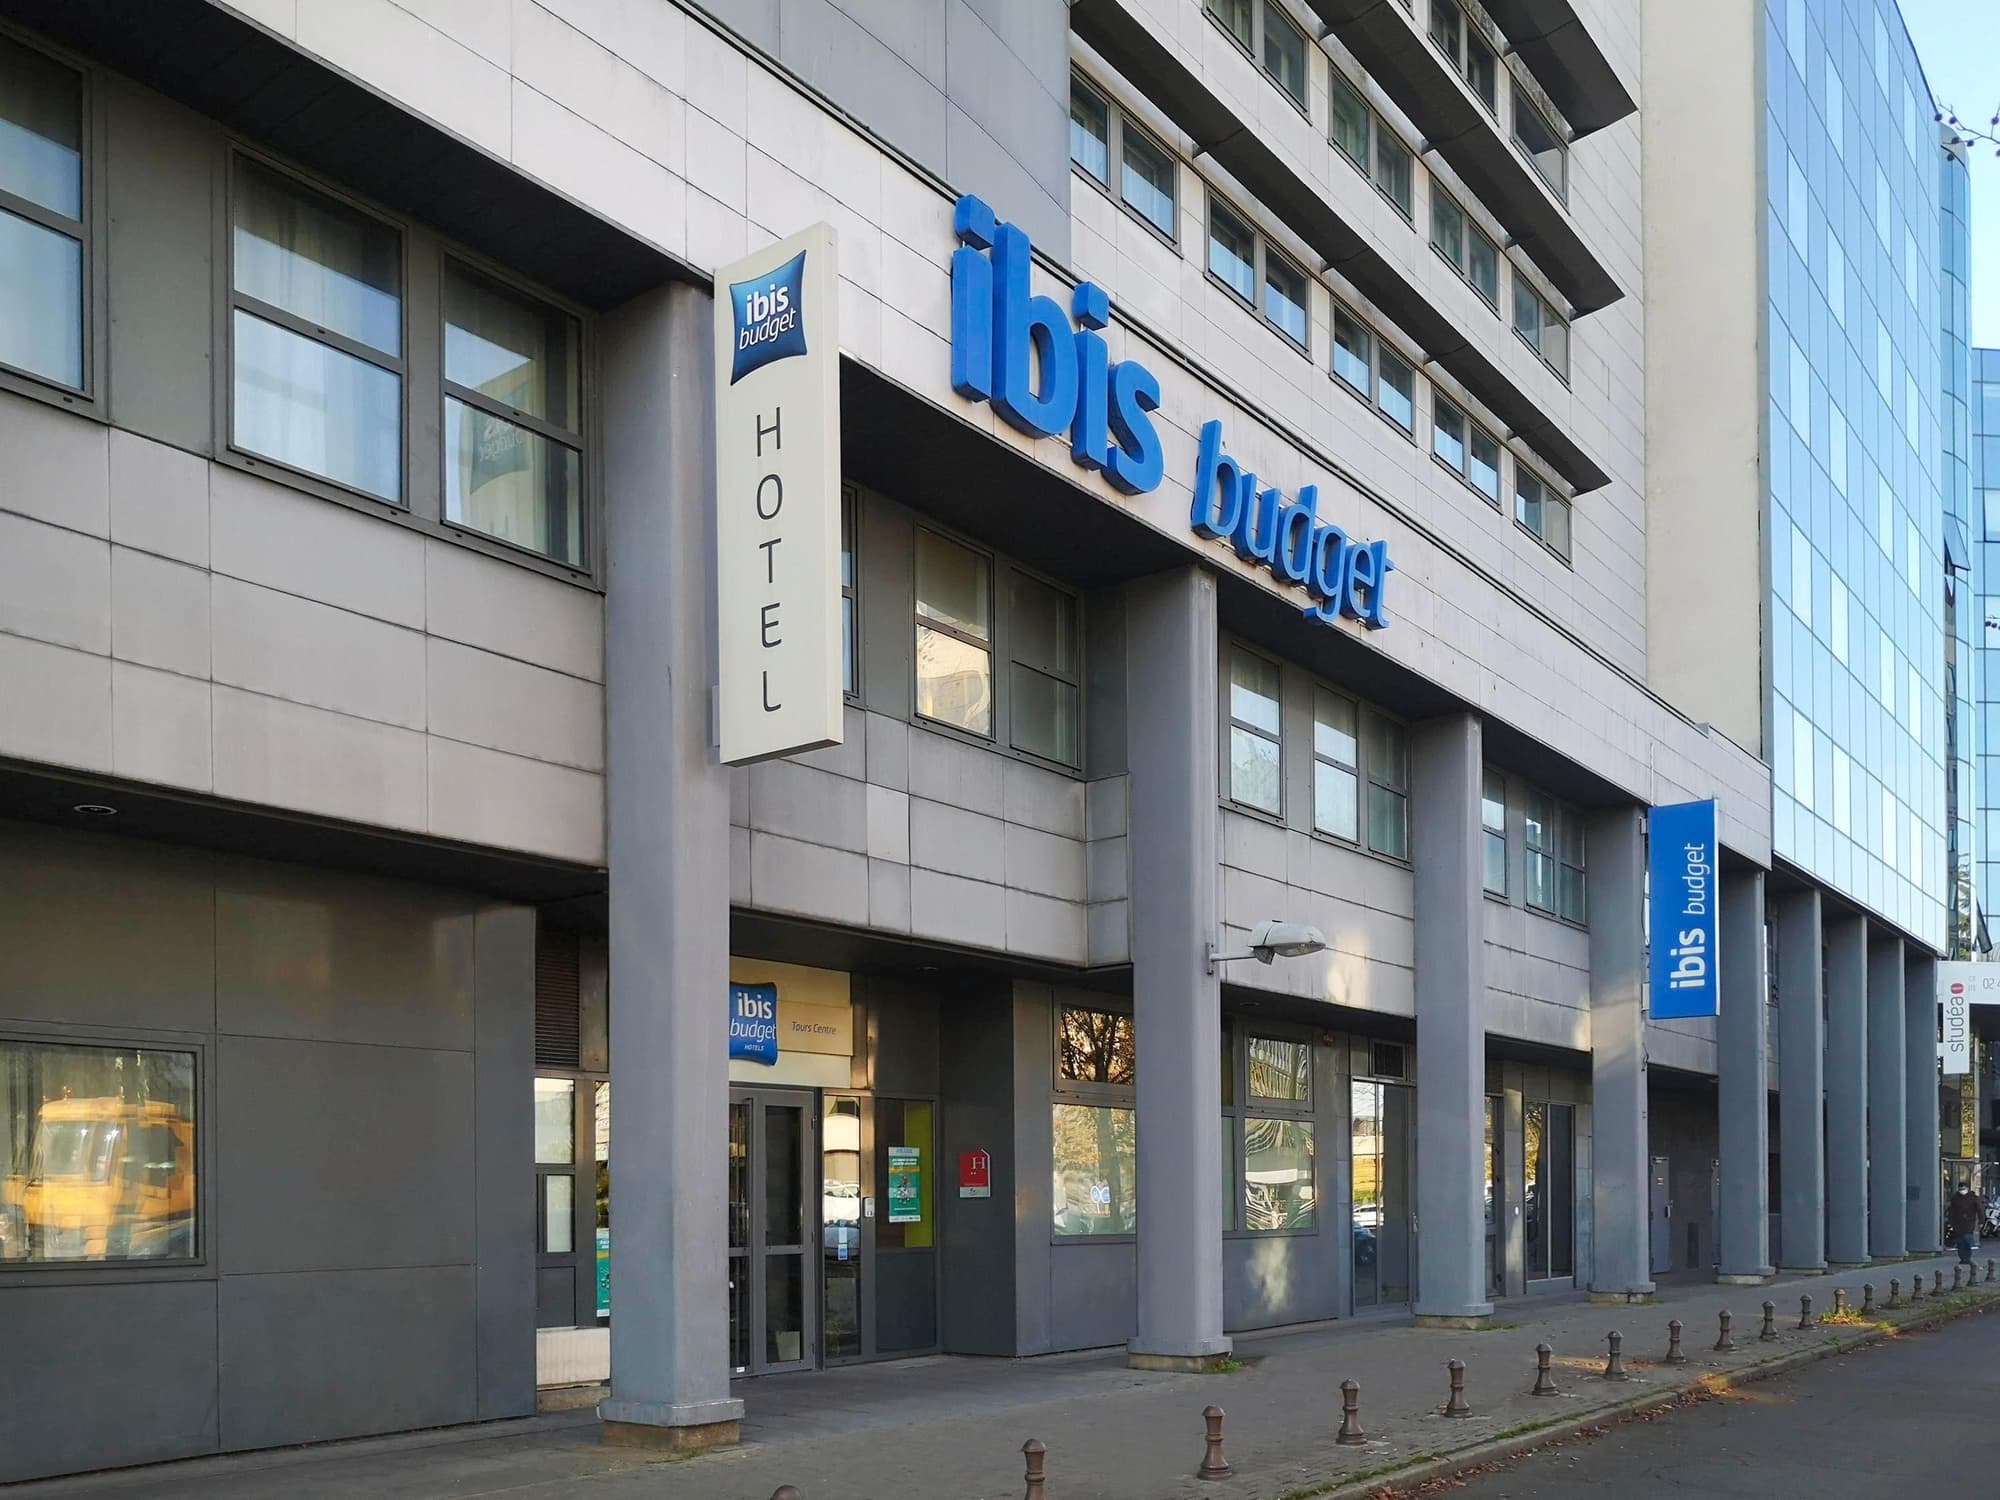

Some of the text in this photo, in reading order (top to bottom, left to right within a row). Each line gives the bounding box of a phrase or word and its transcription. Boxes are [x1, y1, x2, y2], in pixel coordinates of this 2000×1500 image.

[746, 283, 789, 325] ibis
[739, 307, 796, 350] budget
[951, 194, 1394, 630] ibis budget
[756, 406, 783, 712] HOTEL
[1670, 842, 1711, 989] ibis budget
[737, 992, 773, 1019] ibis
[1946, 996, 1965, 1053] studéa
[729, 1018, 777, 1042] budget
[743, 1043, 765, 1052] HOTELS
[791, 1020, 837, 1035] Tours Centre
[971, 1157, 985, 1169] H
